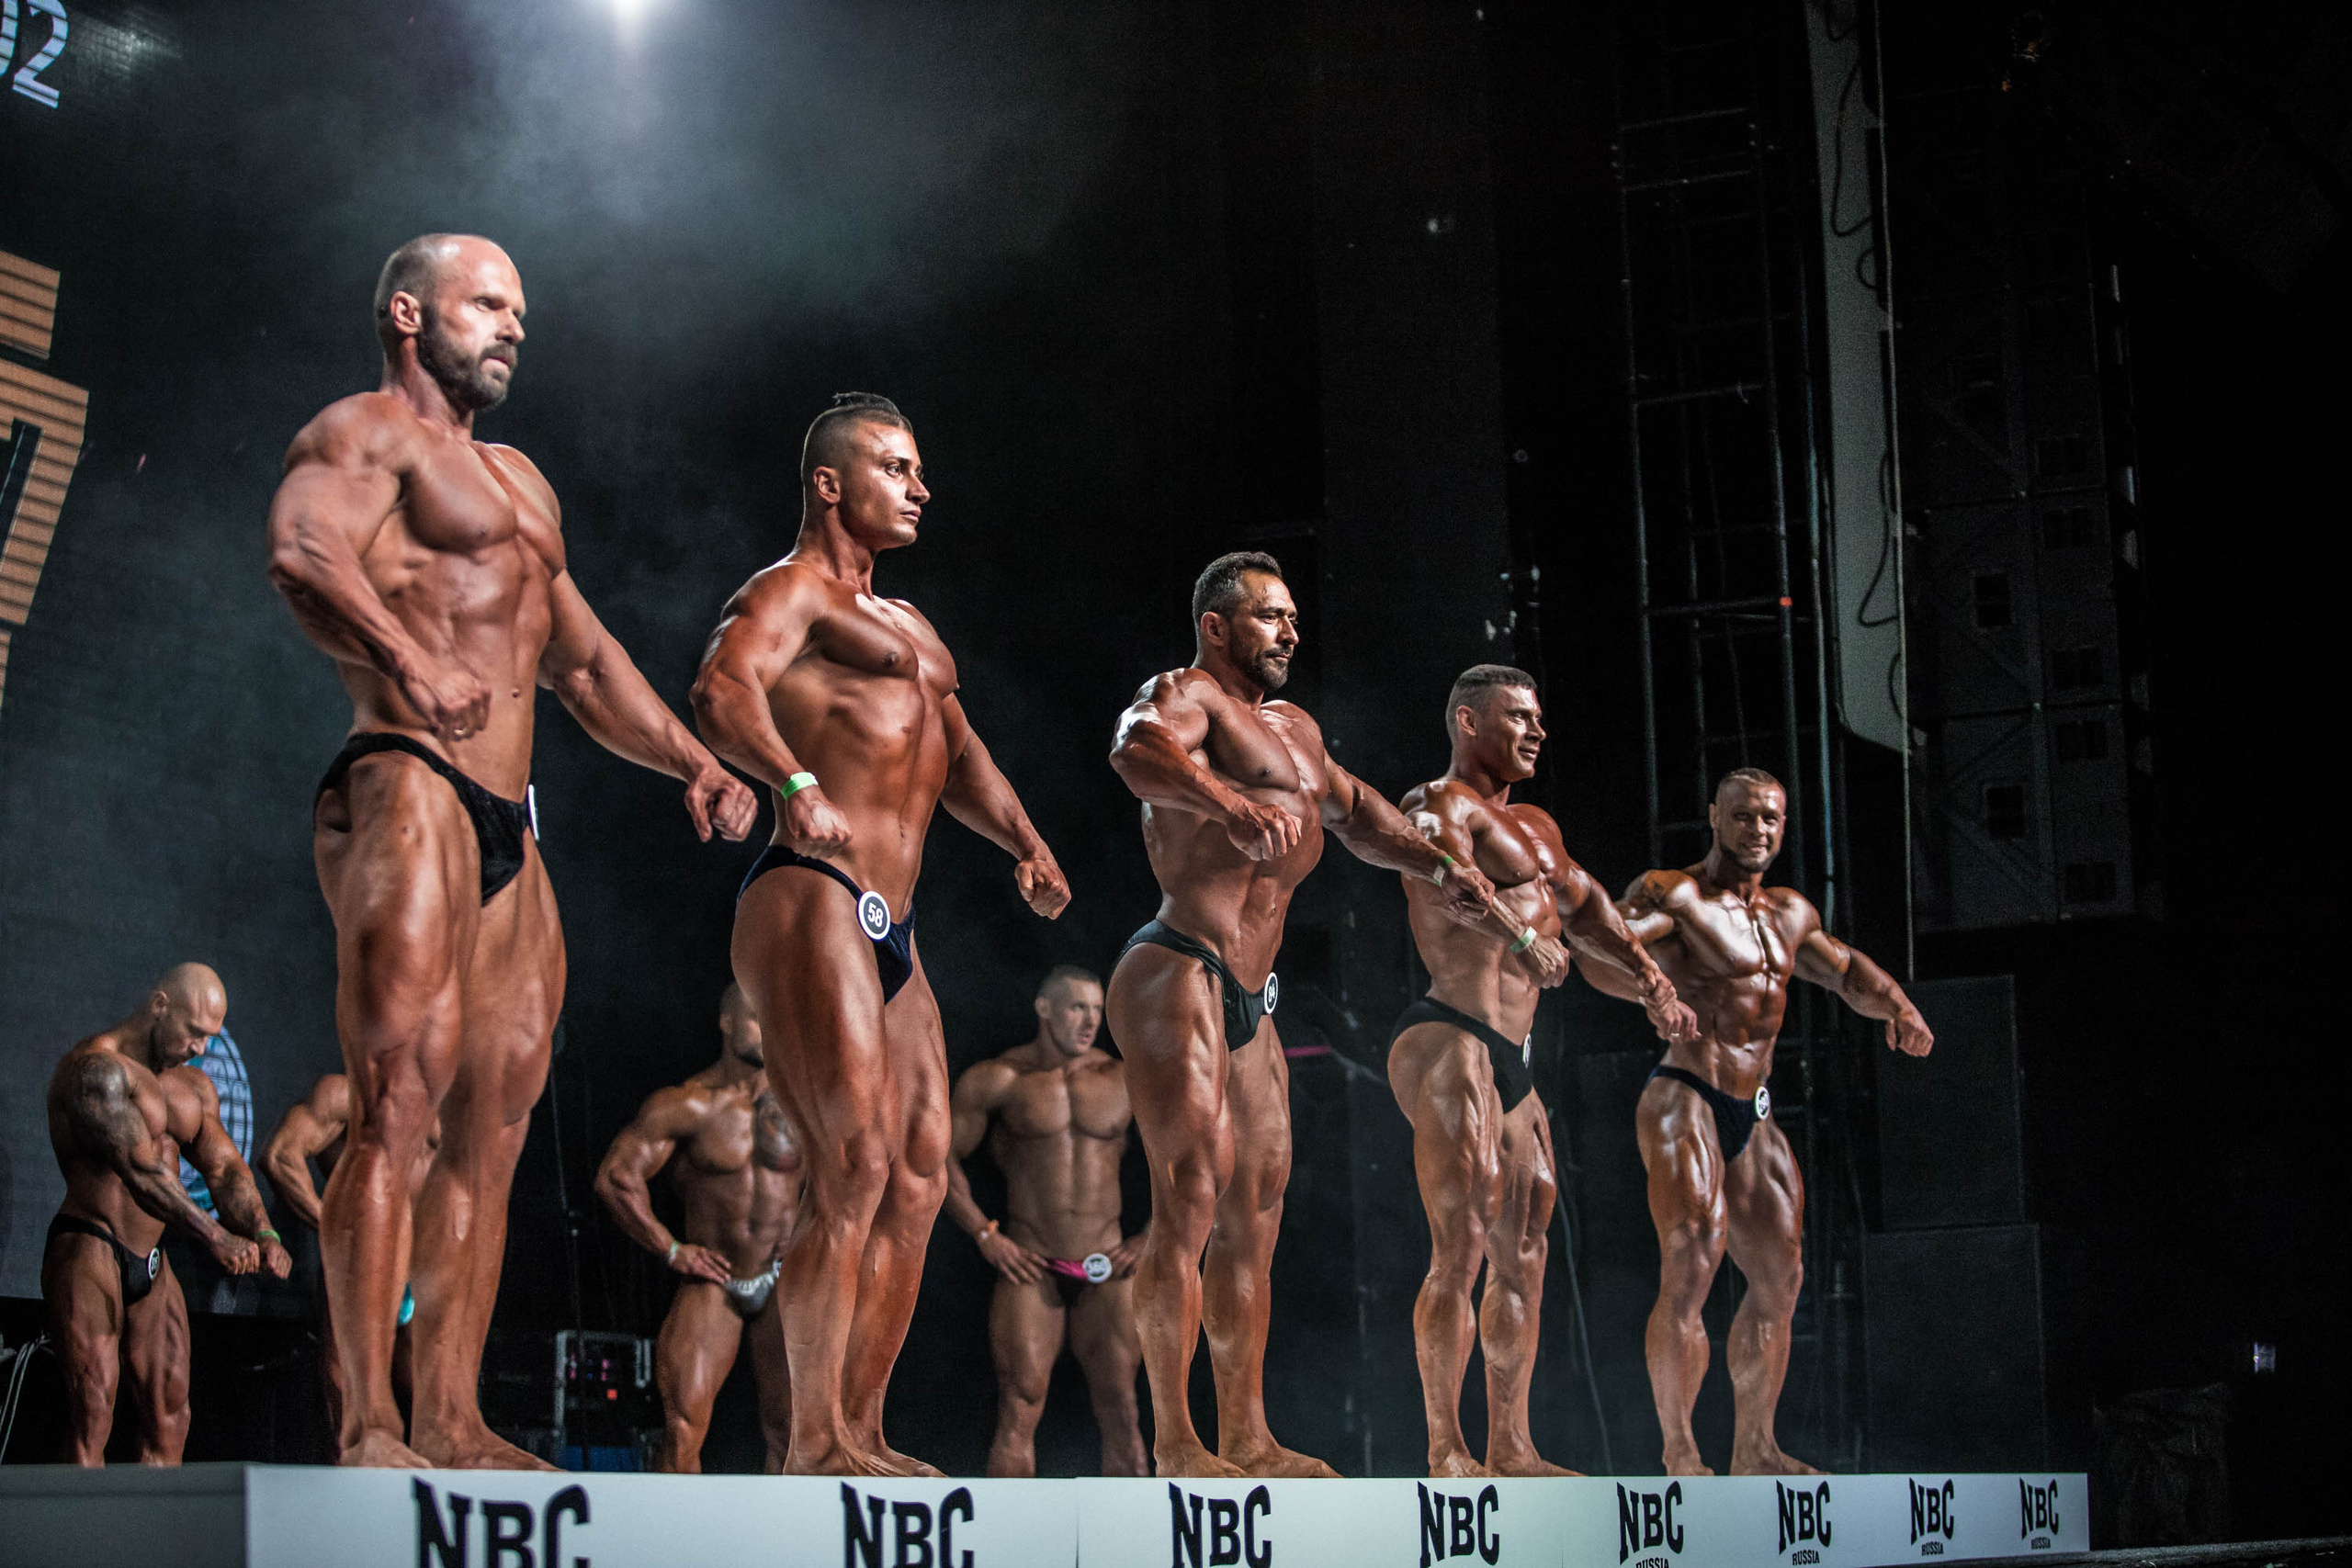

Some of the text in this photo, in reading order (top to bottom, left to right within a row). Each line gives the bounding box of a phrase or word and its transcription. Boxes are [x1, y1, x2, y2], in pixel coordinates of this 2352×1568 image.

[867, 902, 884, 928] 58
[411, 1476, 591, 1568] NBC
[841, 1481, 975, 1568] NBC
[1168, 1481, 1272, 1568] NBC
[1418, 1480, 1500, 1568] NBC
[1616, 1480, 1684, 1565] NBC
[1776, 1479, 1832, 1555] NBC
[1909, 1477, 1955, 1546] NBC
[2019, 1477, 2060, 1540] NBC
[2030, 1536, 2052, 1550] RUSSIA
[1792, 1549, 1820, 1566] RUSSIA
[1921, 1540, 1944, 1556] RUSSIA
